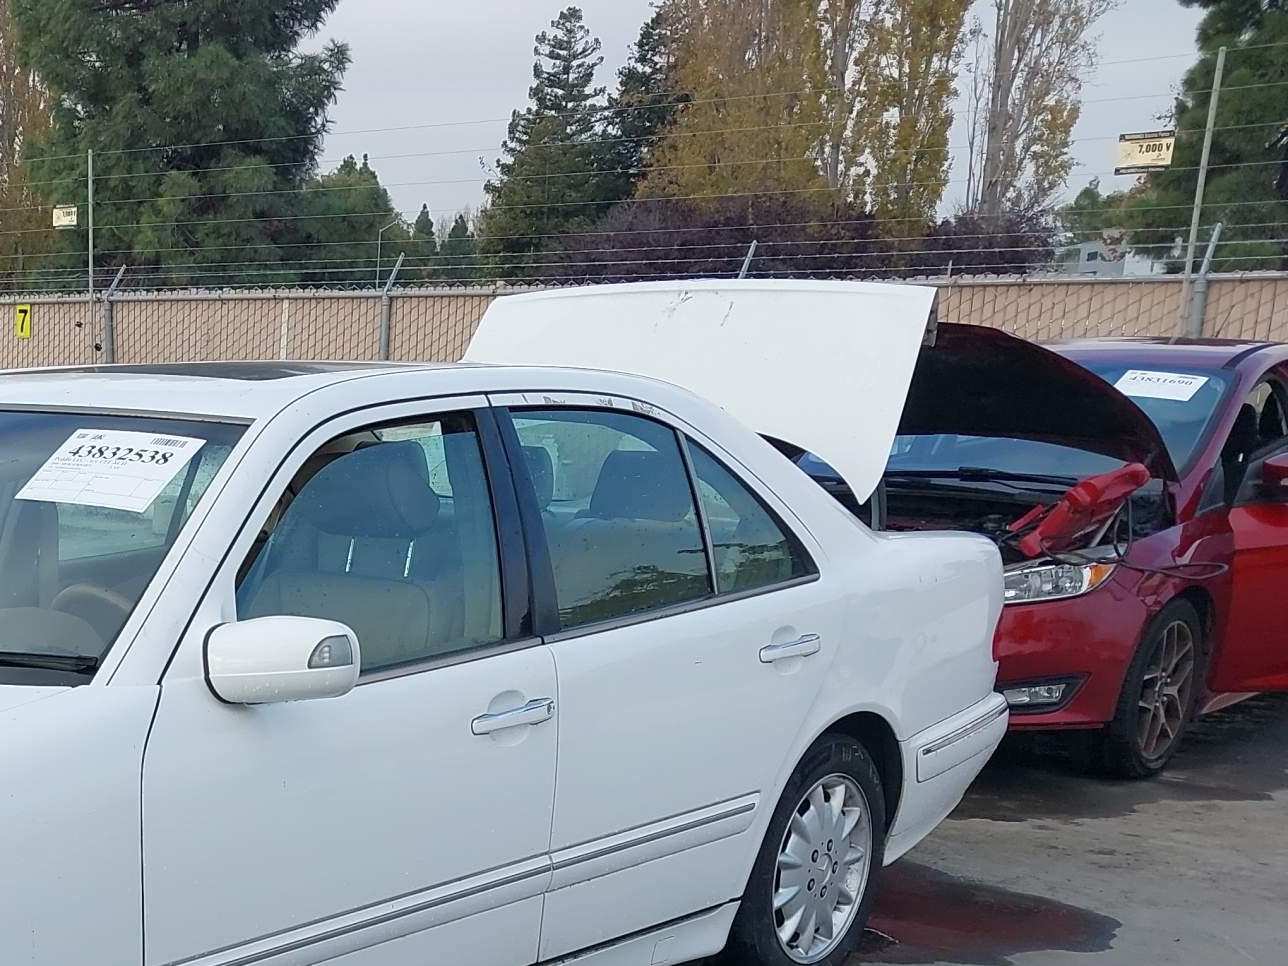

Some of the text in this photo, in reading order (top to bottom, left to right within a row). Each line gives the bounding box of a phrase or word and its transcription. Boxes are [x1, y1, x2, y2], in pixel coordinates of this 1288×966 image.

[1138, 142, 1172, 154] 7,000 V
[18, 309, 29, 333] 7
[68, 444, 174, 465] 43832538
